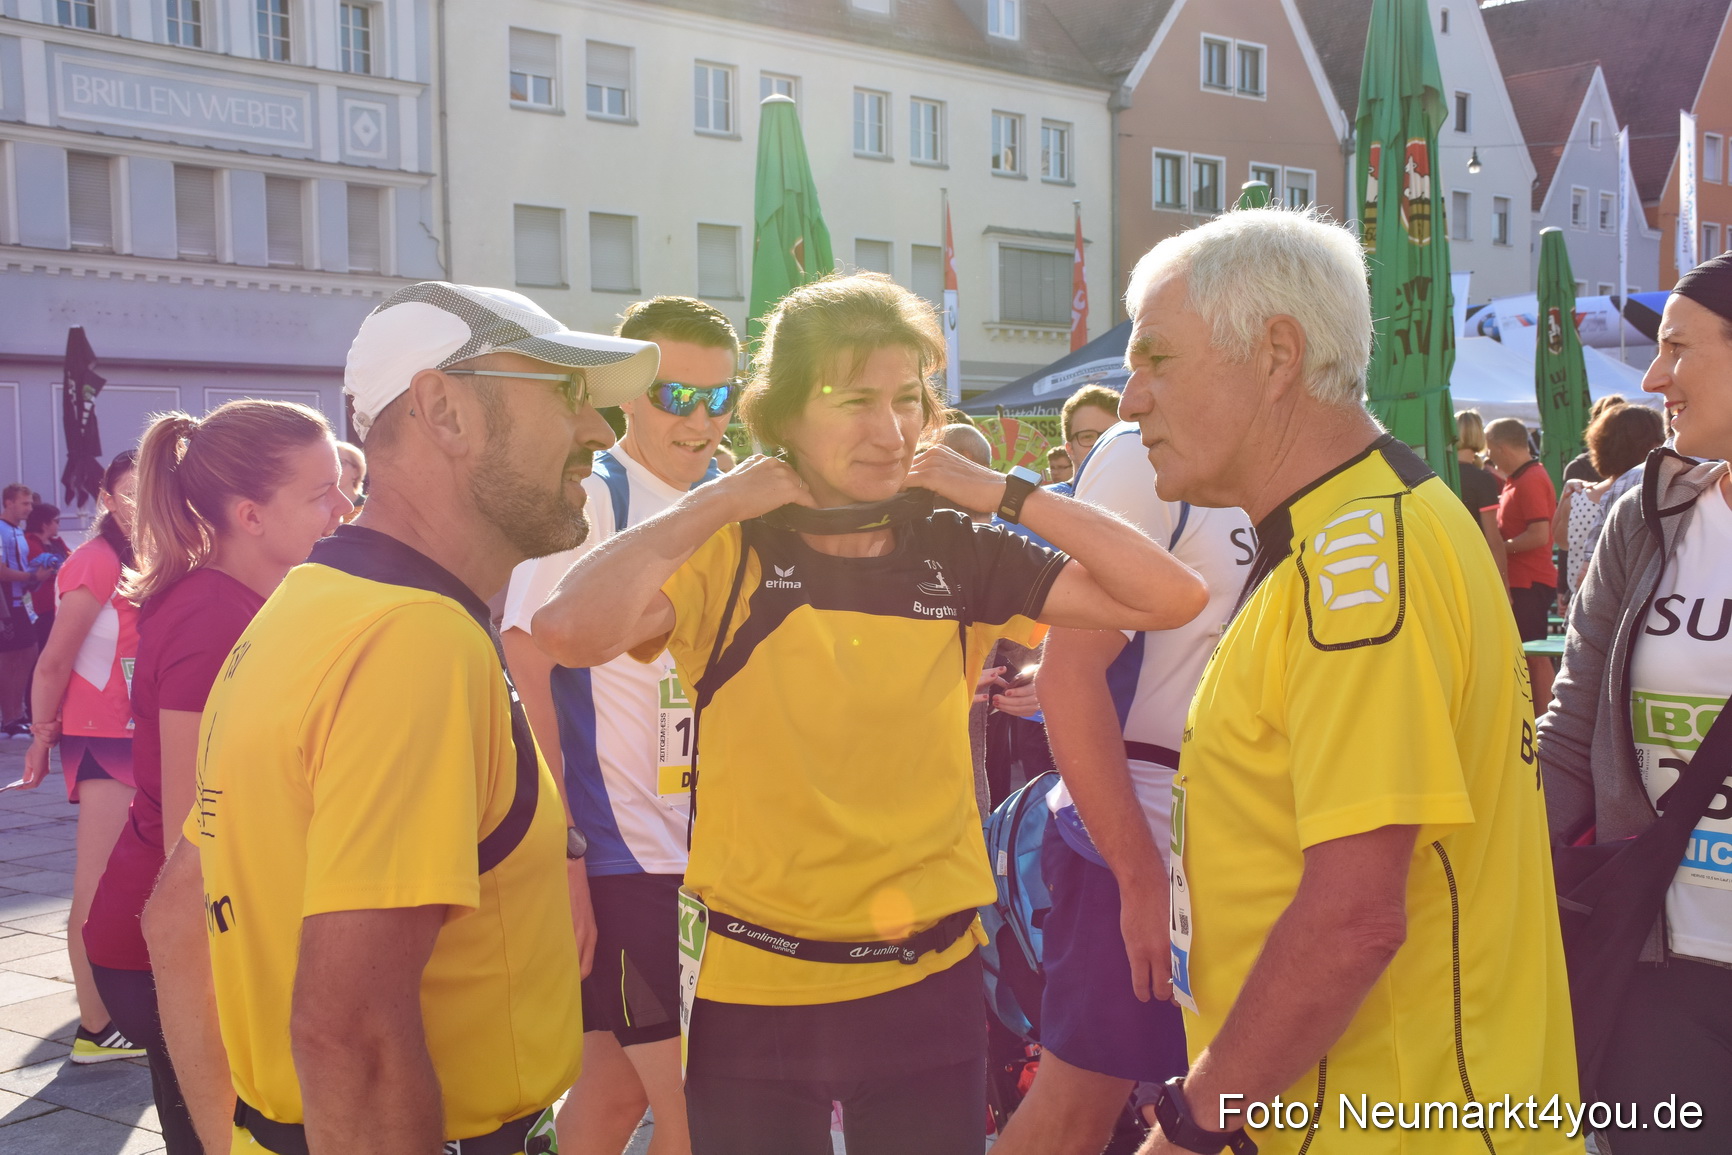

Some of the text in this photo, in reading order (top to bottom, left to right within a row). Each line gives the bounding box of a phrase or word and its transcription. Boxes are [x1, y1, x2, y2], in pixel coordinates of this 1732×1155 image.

[71, 74, 299, 133] BRILLEN WEBER
[765, 578, 802, 590] erima
[747, 929, 800, 950] unlimited
[771, 943, 796, 955] running
